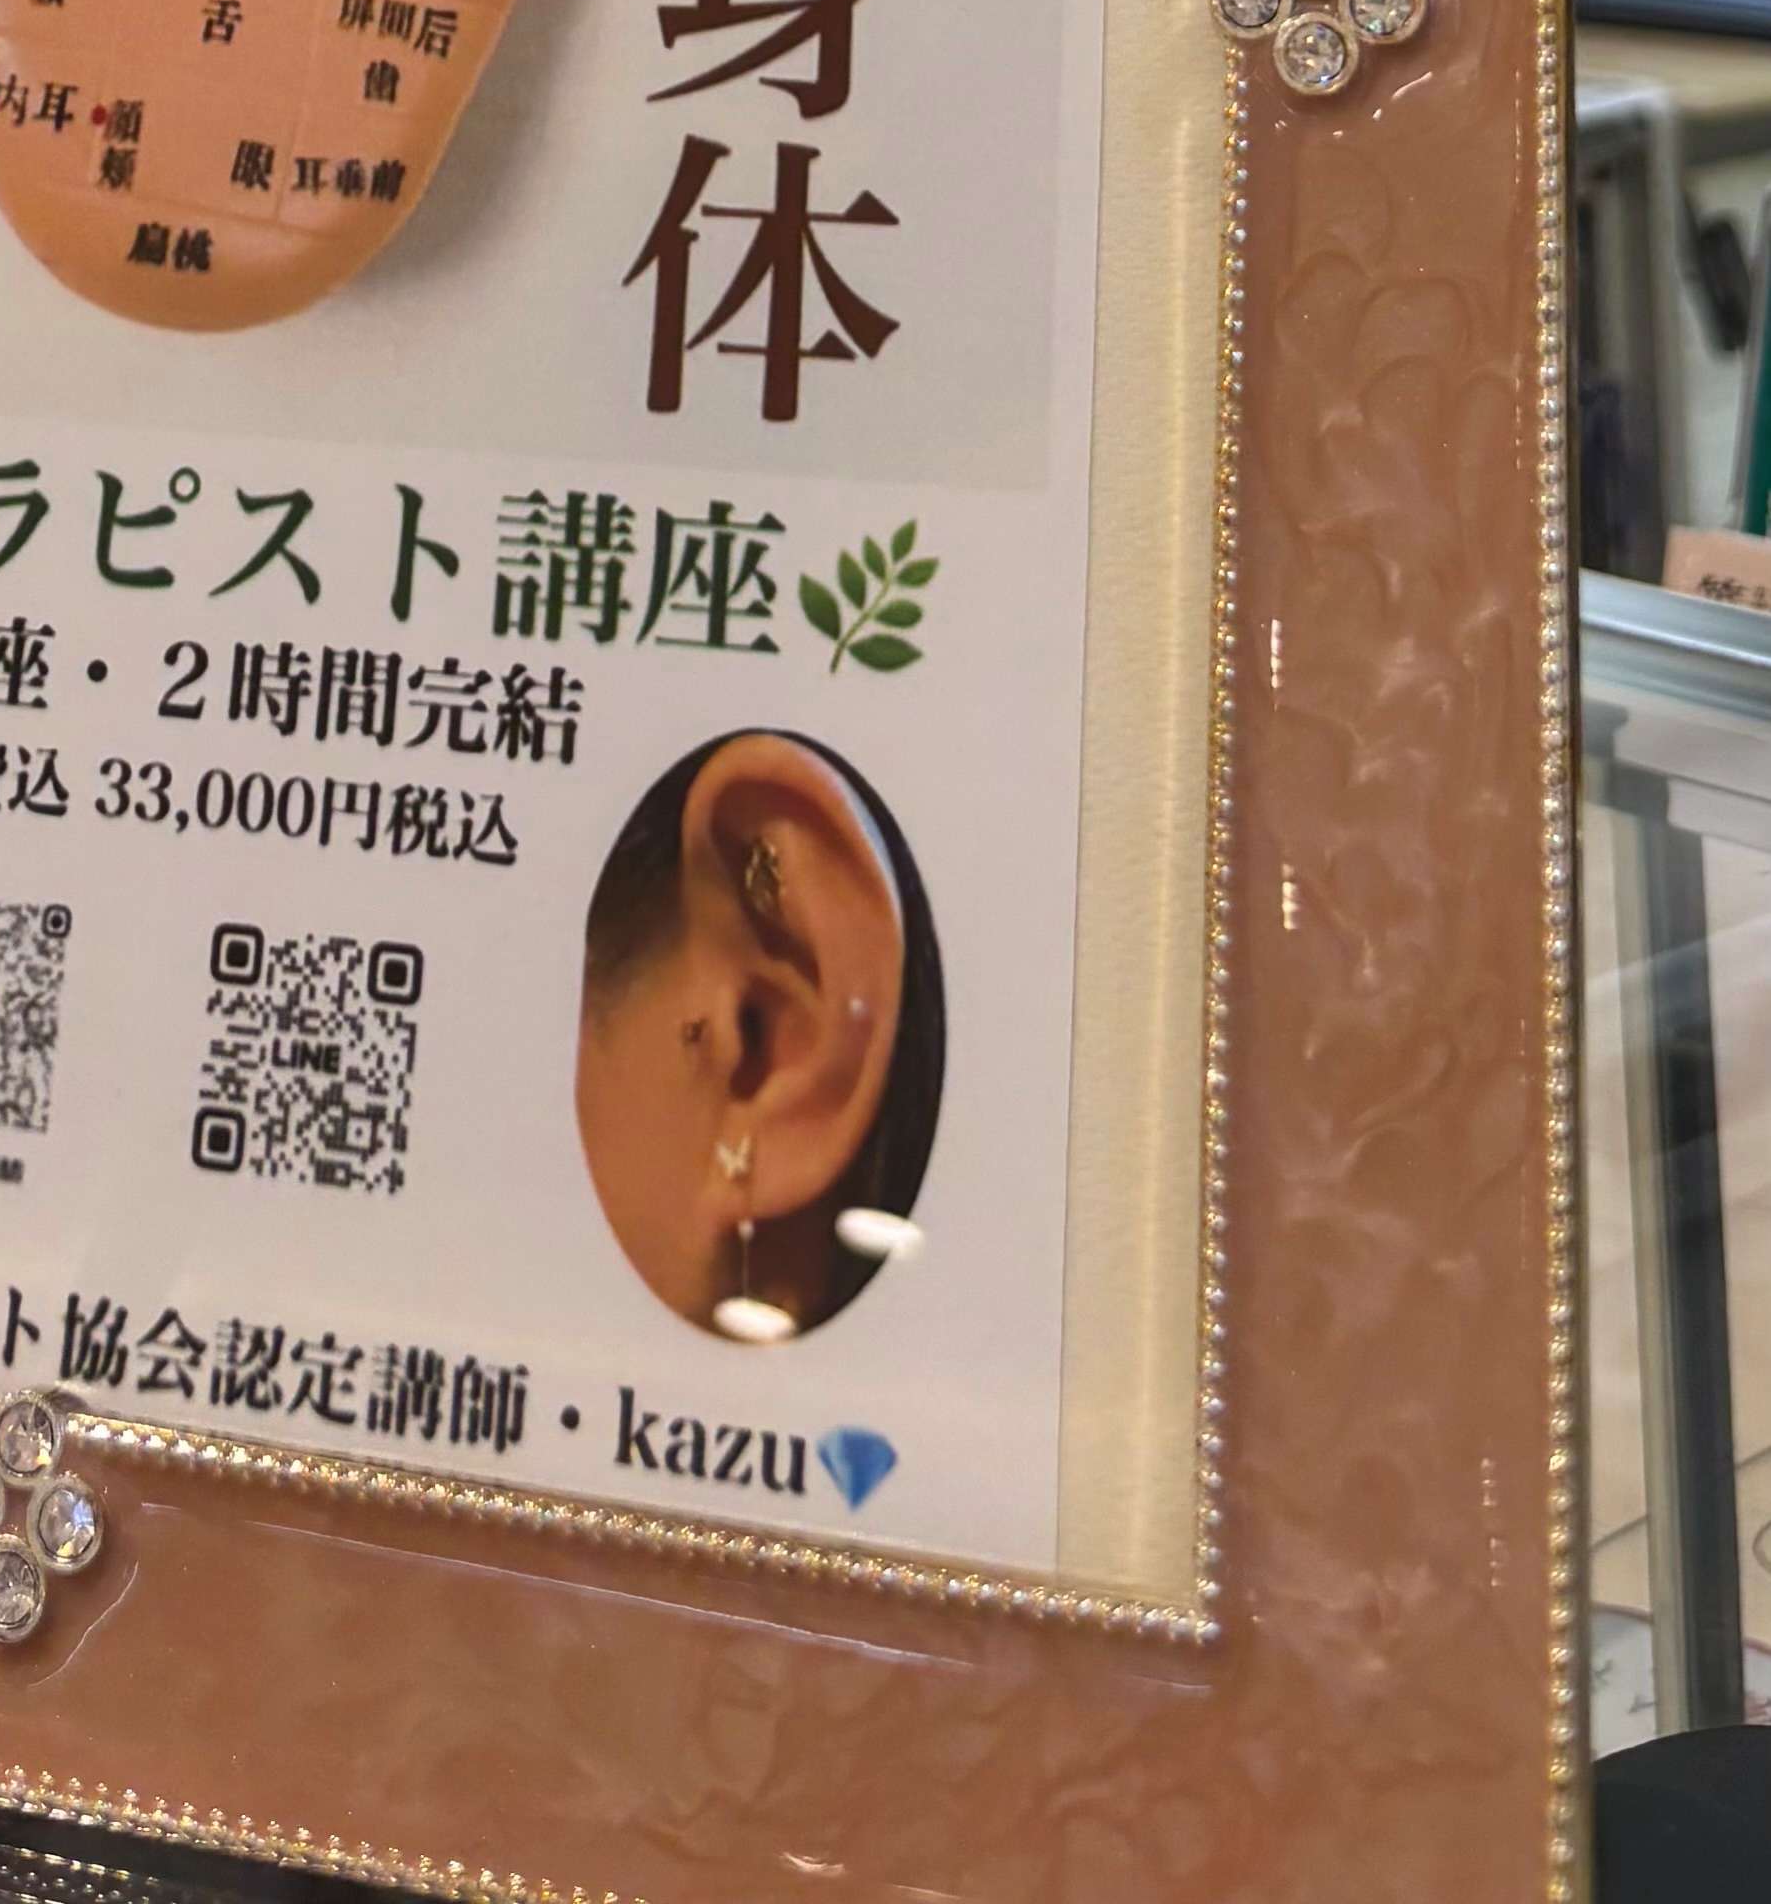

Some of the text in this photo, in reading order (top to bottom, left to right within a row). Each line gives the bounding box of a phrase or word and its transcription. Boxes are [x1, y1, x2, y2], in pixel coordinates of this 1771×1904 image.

[94, 755, 520, 868] 33,000円税込
[272, 1037, 343, 1076] LINE
